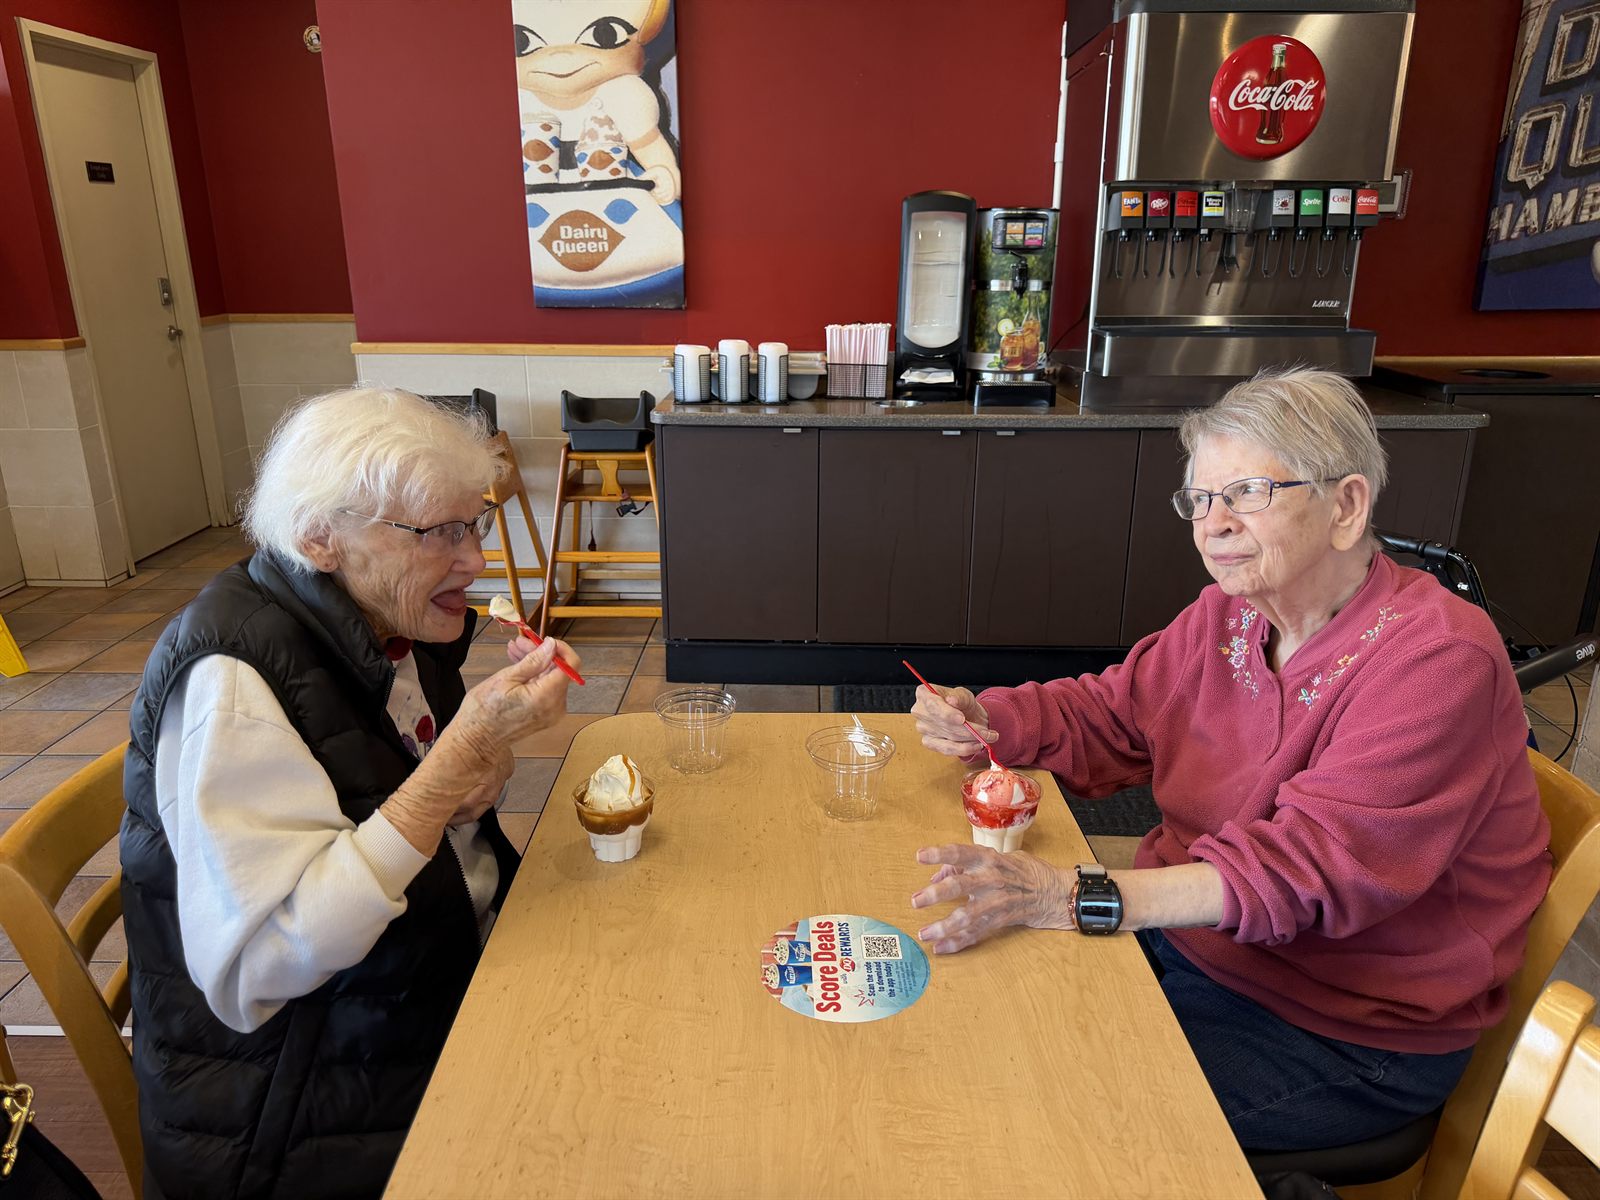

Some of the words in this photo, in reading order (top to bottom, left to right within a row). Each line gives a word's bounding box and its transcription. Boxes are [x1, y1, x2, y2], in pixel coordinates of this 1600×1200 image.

[1303, 198, 1321, 206] Sprite
[560, 223, 608, 240] Dairy
[552, 240, 609, 257] Queen
[811, 920, 837, 962] Deals
[864, 961, 873, 974] code
[873, 961, 885, 986] download
[866, 974, 874, 983] the
[887, 977, 897, 988] app
[815, 965, 842, 1013] Score
[867, 983, 876, 997] Scan
[888, 988, 896, 998] the
